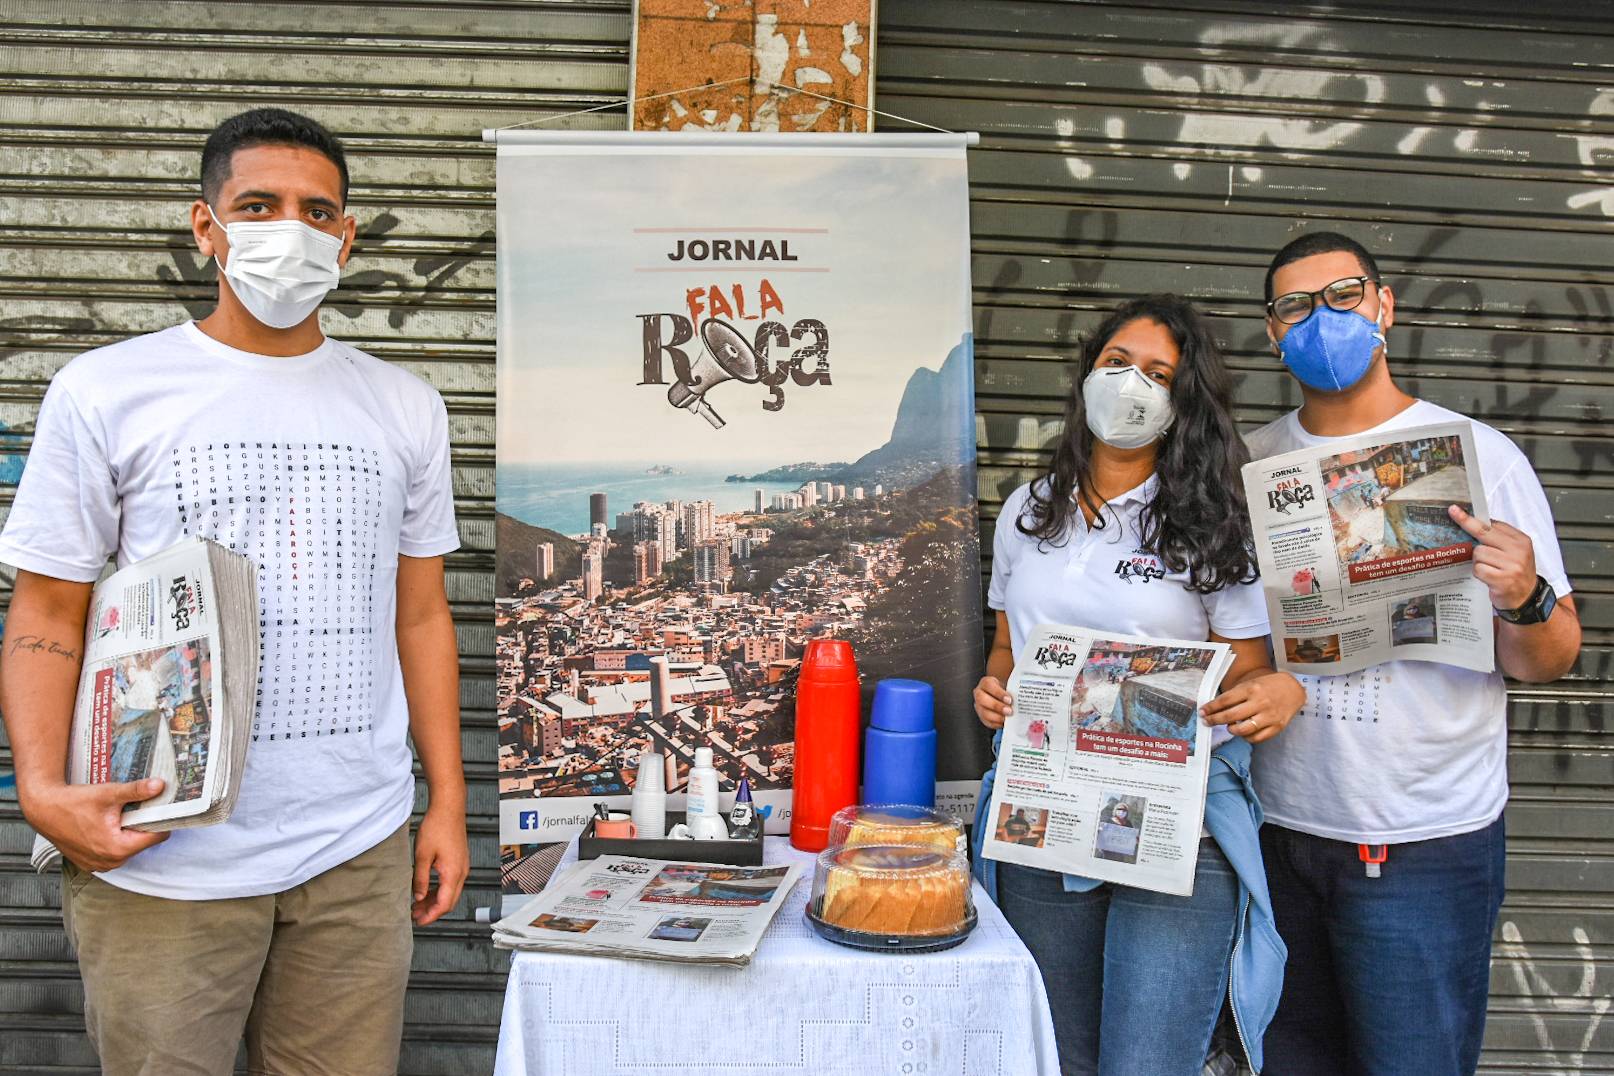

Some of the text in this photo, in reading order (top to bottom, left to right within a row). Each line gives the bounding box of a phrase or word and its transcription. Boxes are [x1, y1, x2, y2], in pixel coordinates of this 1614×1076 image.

[667, 239, 798, 262] JORNAL
[686, 279, 784, 330] FALA
[1271, 466, 1302, 478] JORNAL
[1277, 477, 1300, 492] FALA
[1132, 558, 1156, 567] FALA
[1355, 546, 1466, 574] Prática de esportes na Rocinha
[1369, 570, 1384, 578] tem
[1399, 563, 1426, 573] desafio
[195, 578, 204, 616] JORNAL
[1049, 634, 1077, 643] JORNAL
[1049, 643, 1070, 652] FALA
[94, 710, 100, 724] um
[103, 704, 109, 716] de
[93, 725, 101, 756] desafio
[1082, 732, 1105, 742] Prática
[1106, 736, 1114, 744] de
[1115, 737, 1145, 748] esportes
[1154, 741, 1183, 751] Rocinha
[1093, 743, 1107, 751] tem
[1107, 745, 1119, 753] um
[1119, 746, 1144, 756] desafio
[101, 754, 107, 766] na
[100, 766, 108, 784] Roc
[778, 808, 791, 820] /jo
